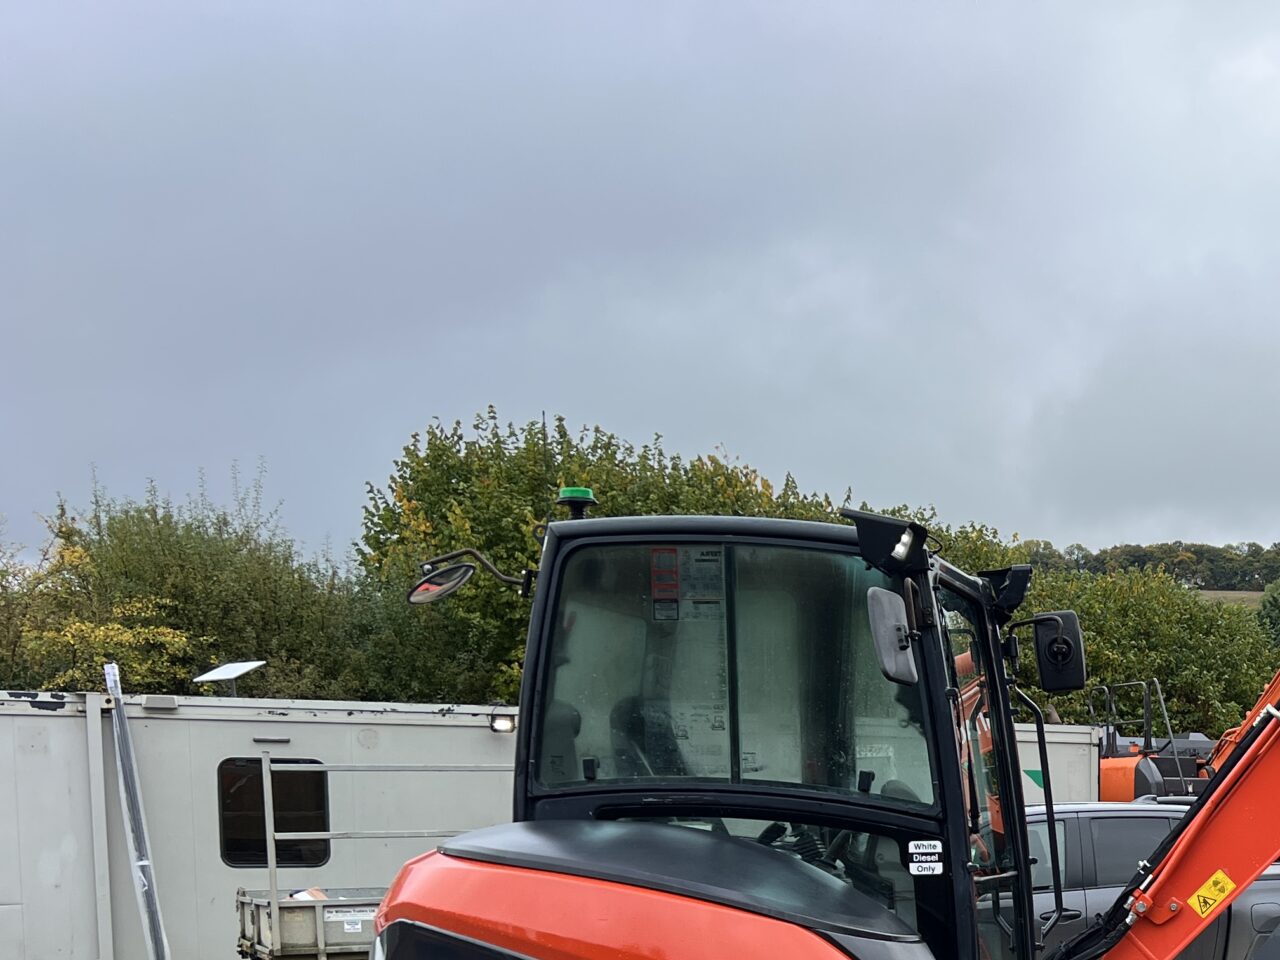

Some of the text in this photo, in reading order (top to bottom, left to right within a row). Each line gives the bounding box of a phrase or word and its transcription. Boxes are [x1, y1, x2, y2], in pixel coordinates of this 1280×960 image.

[913, 843, 938, 851] White
[912, 853, 939, 862] Diesel
[916, 865, 936, 873] Only
